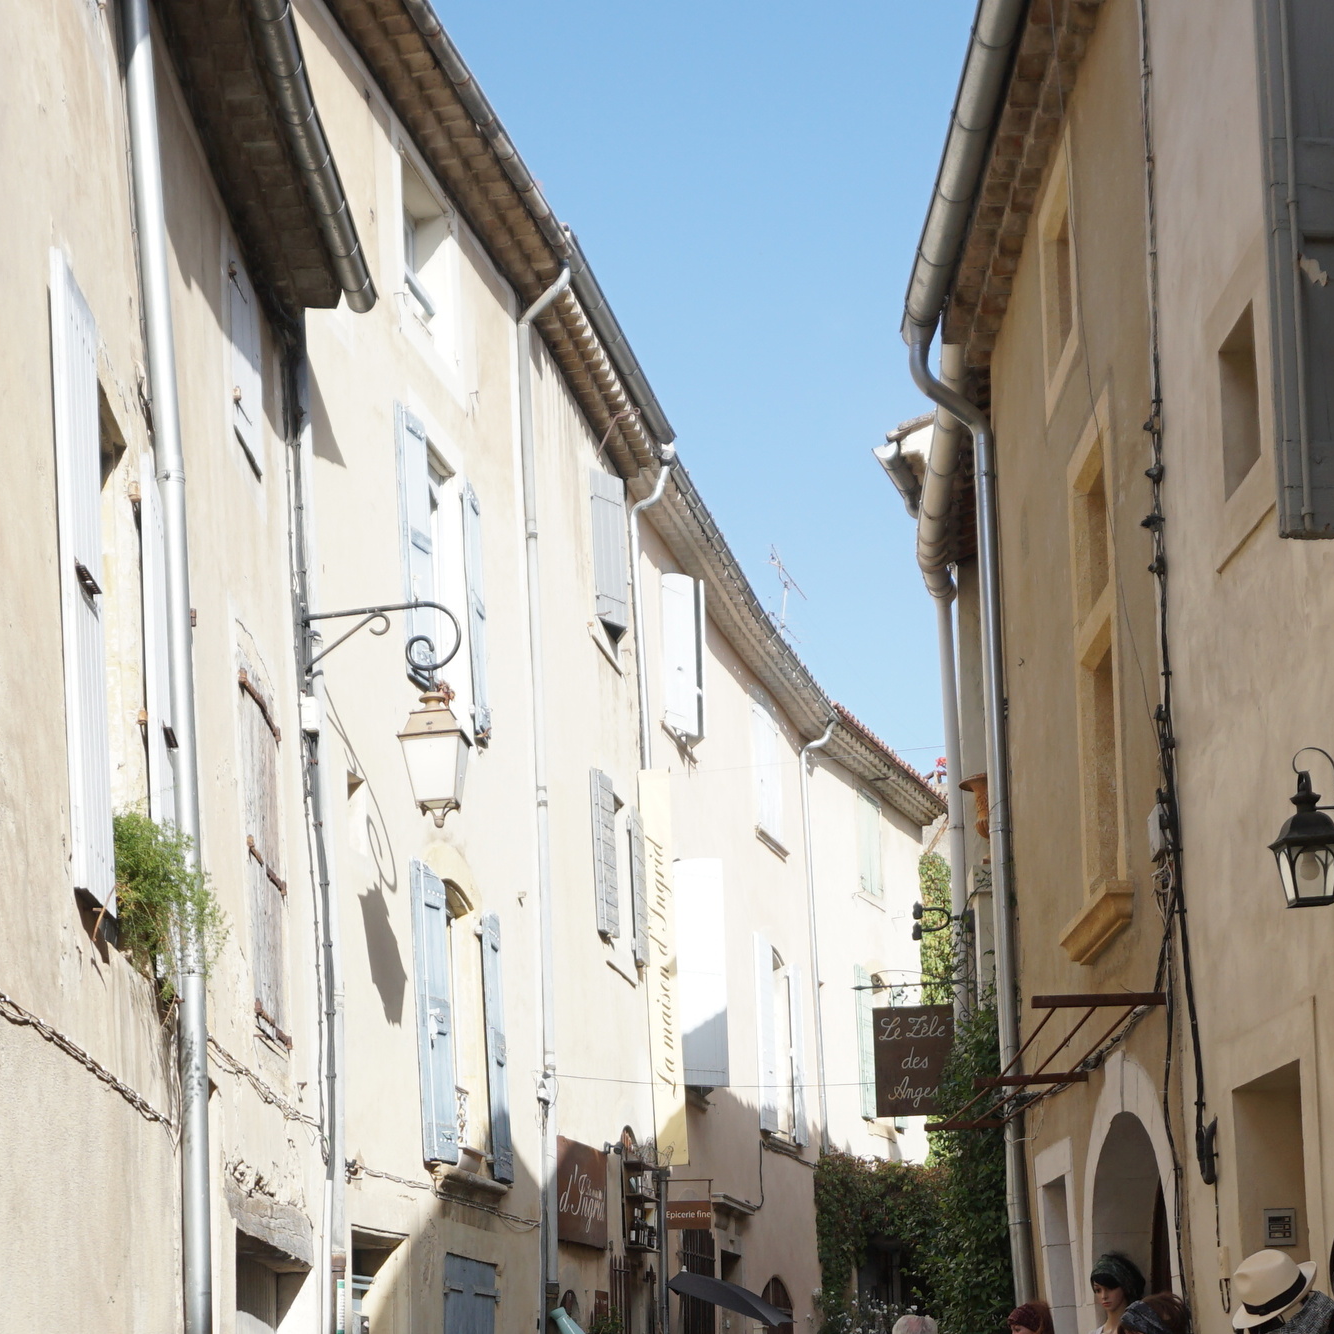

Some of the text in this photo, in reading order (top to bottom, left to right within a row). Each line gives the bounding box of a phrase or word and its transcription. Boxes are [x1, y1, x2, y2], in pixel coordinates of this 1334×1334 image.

[644, 835, 677, 1099] La maison d'Ingrid
[878, 1015, 946, 1041] Le Zèle
[901, 1046, 929, 1069] des
[665, 1208, 712, 1220] Epicerie fine
